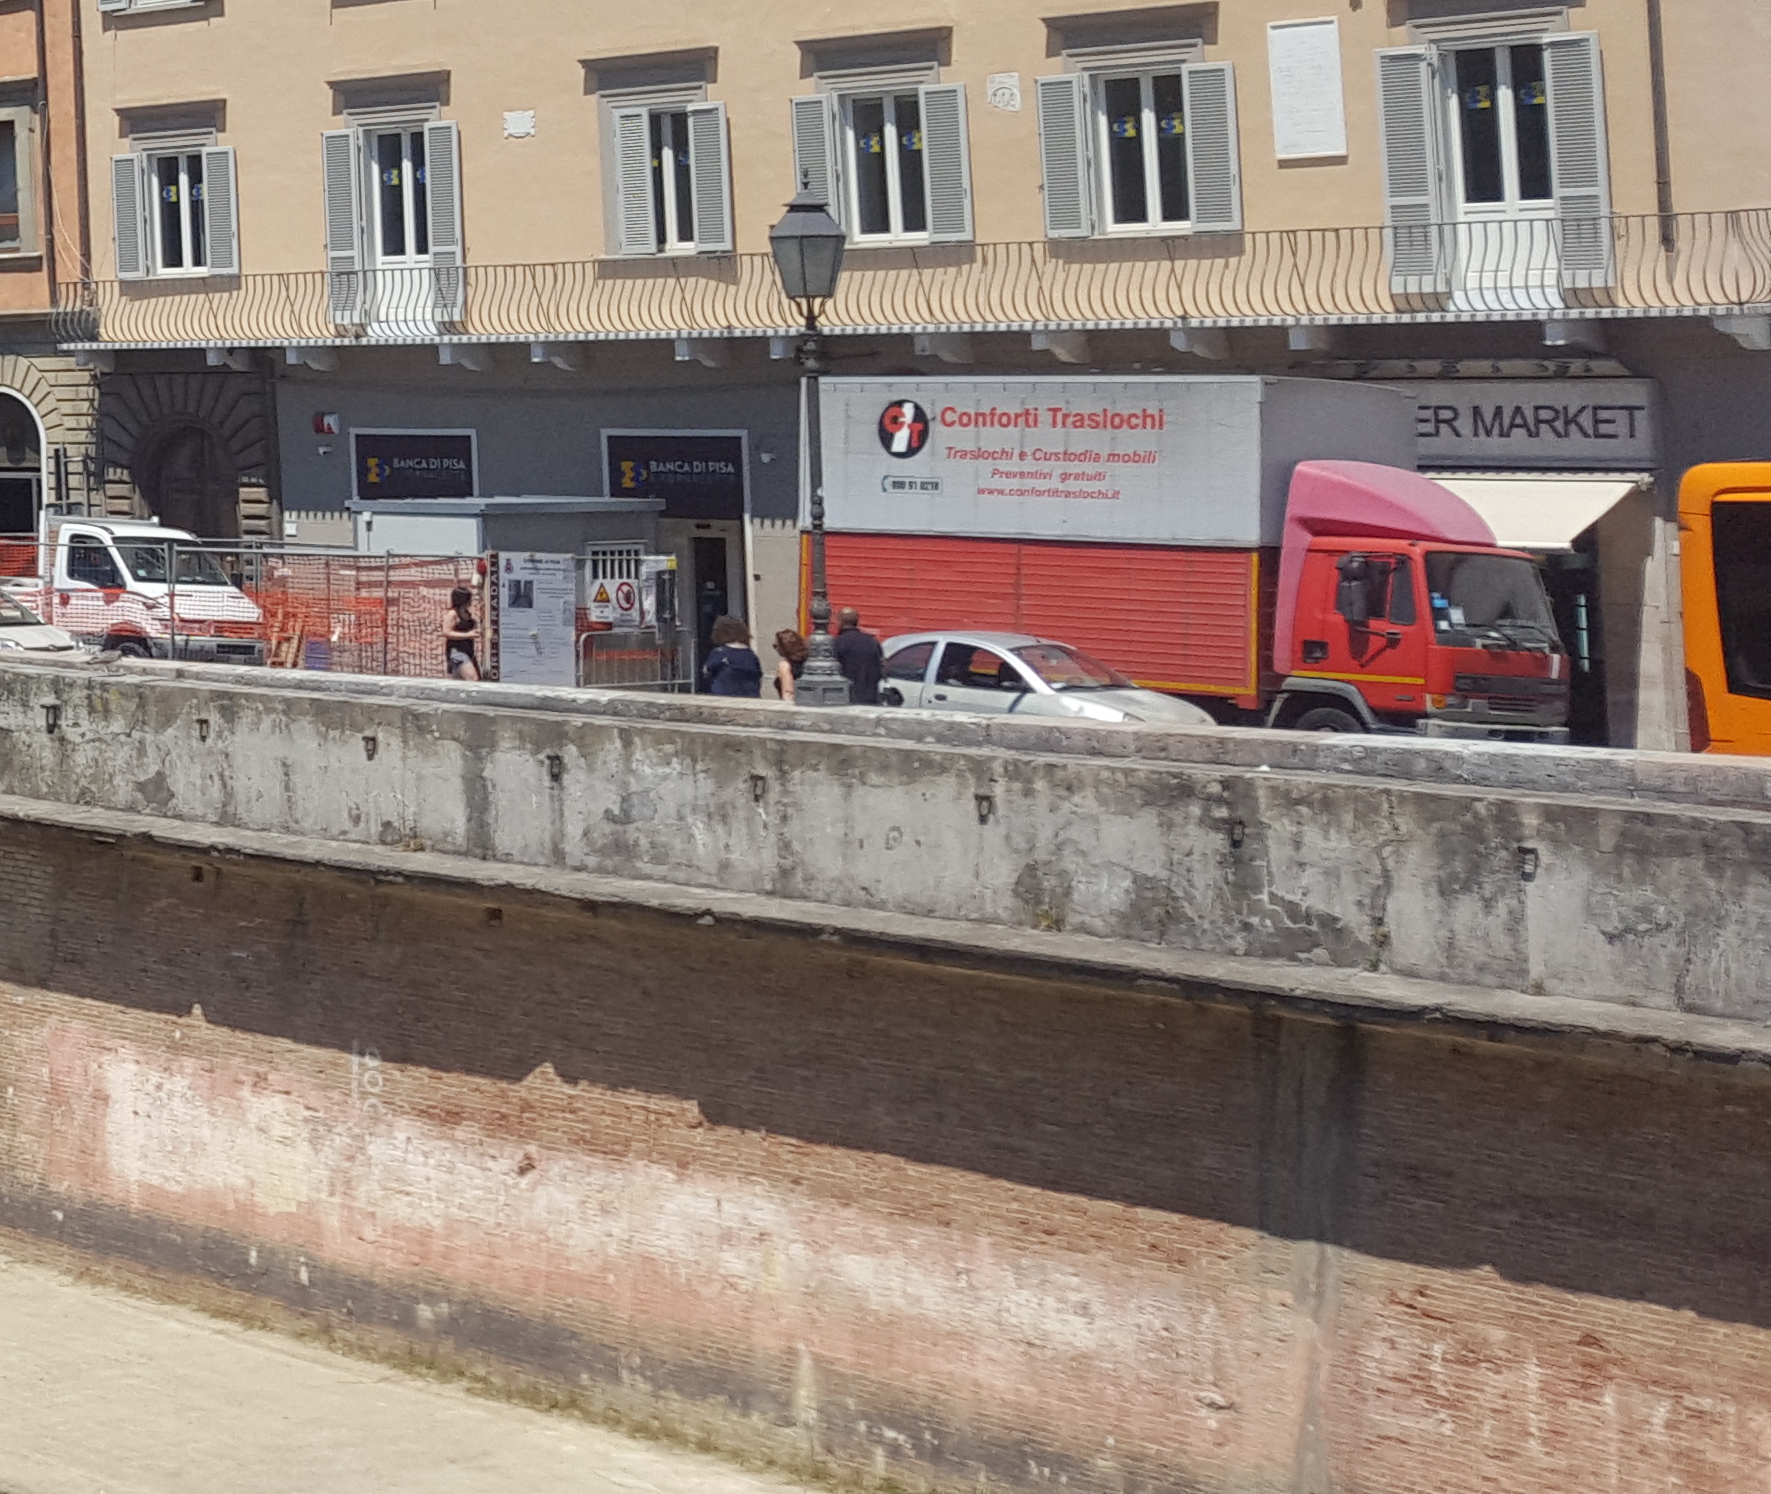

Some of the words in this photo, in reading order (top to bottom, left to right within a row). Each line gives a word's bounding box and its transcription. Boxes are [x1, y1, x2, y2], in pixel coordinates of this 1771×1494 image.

[939, 406, 1039, 429] Conforti
[1047, 407, 1165, 431] Traslochi
[1471, 405, 1647, 439] MARKET
[392, 457, 427, 470] BANCA
[429, 457, 440, 470] DI
[442, 457, 467, 470] PISA
[945, 447, 1014, 462] Traslochi
[1018, 451, 1027, 462] e
[1032, 448, 1102, 464] Custodia
[1106, 450, 1158, 465] mobili
[648, 460, 691, 473] BANCA
[692, 460, 707, 473] DI
[708, 461, 736, 474] PISA
[990, 467, 1053, 481] Preventivi
[1059, 470, 1108, 483] gratuiti
[976, 486, 1121, 501] www.confortitraslochi.it
